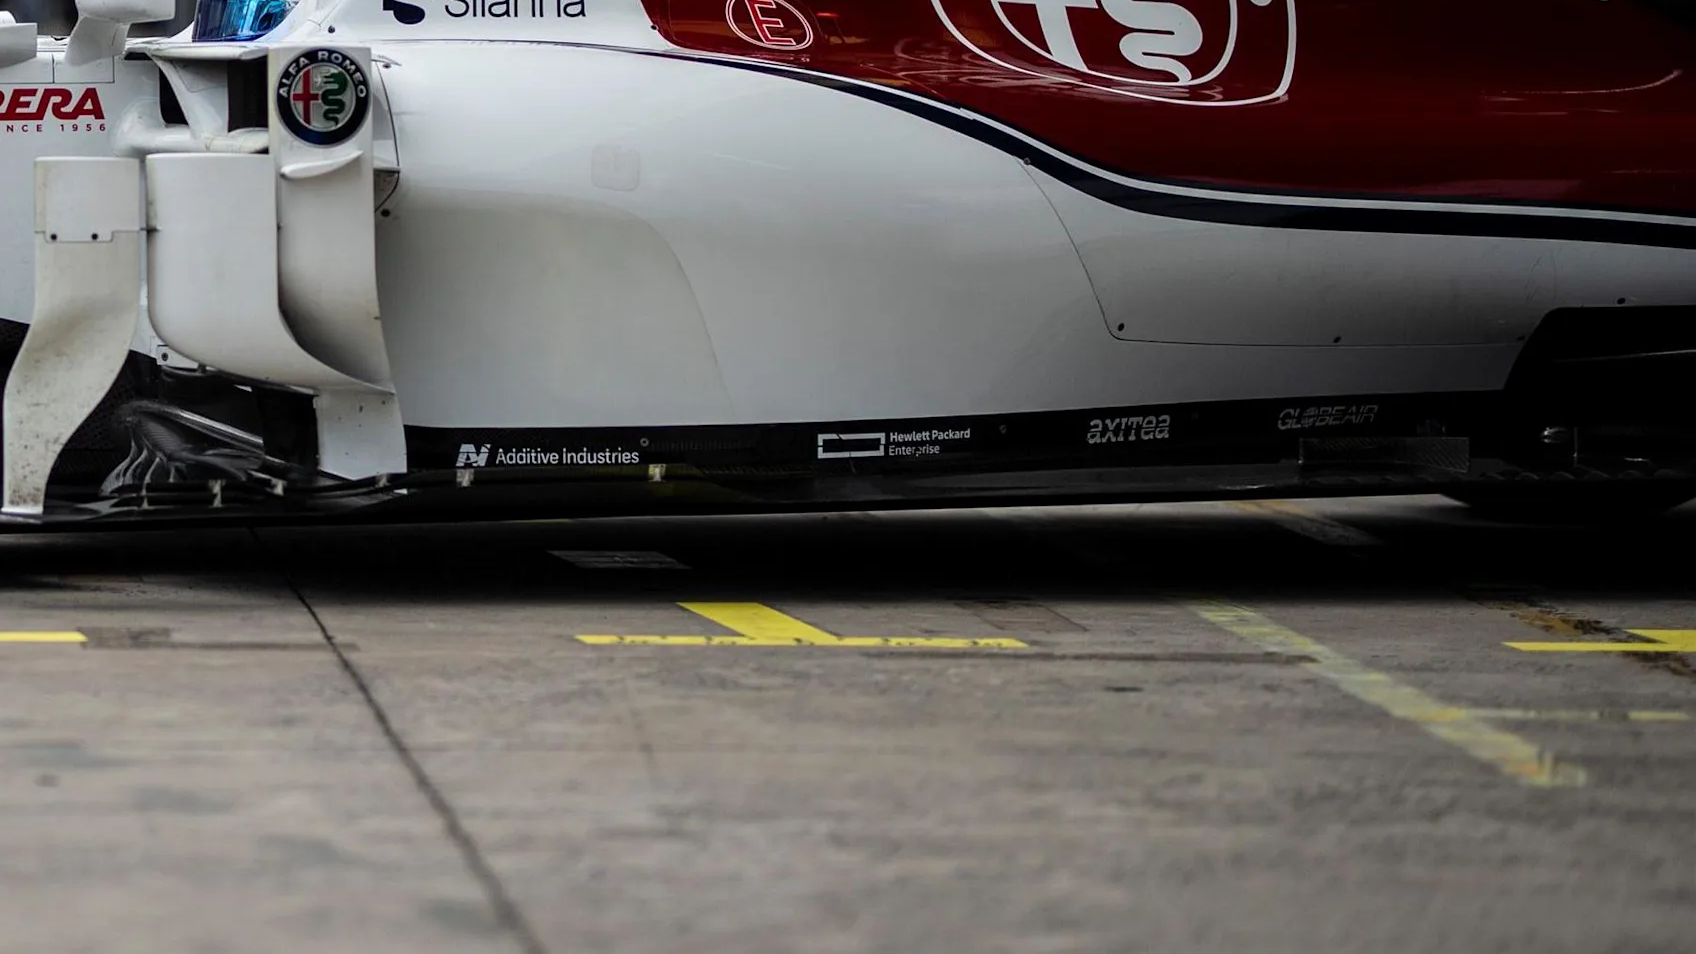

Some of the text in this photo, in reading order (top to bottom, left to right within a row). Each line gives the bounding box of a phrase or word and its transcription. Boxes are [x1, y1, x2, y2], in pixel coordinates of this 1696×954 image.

[279, 51, 367, 98] ALFA ROMEO
[60, 124, 106, 132] 1956
[890, 428, 971, 443] Hewlett Packard
[496, 447, 559, 464] Additive
[562, 447, 640, 464] Industries
